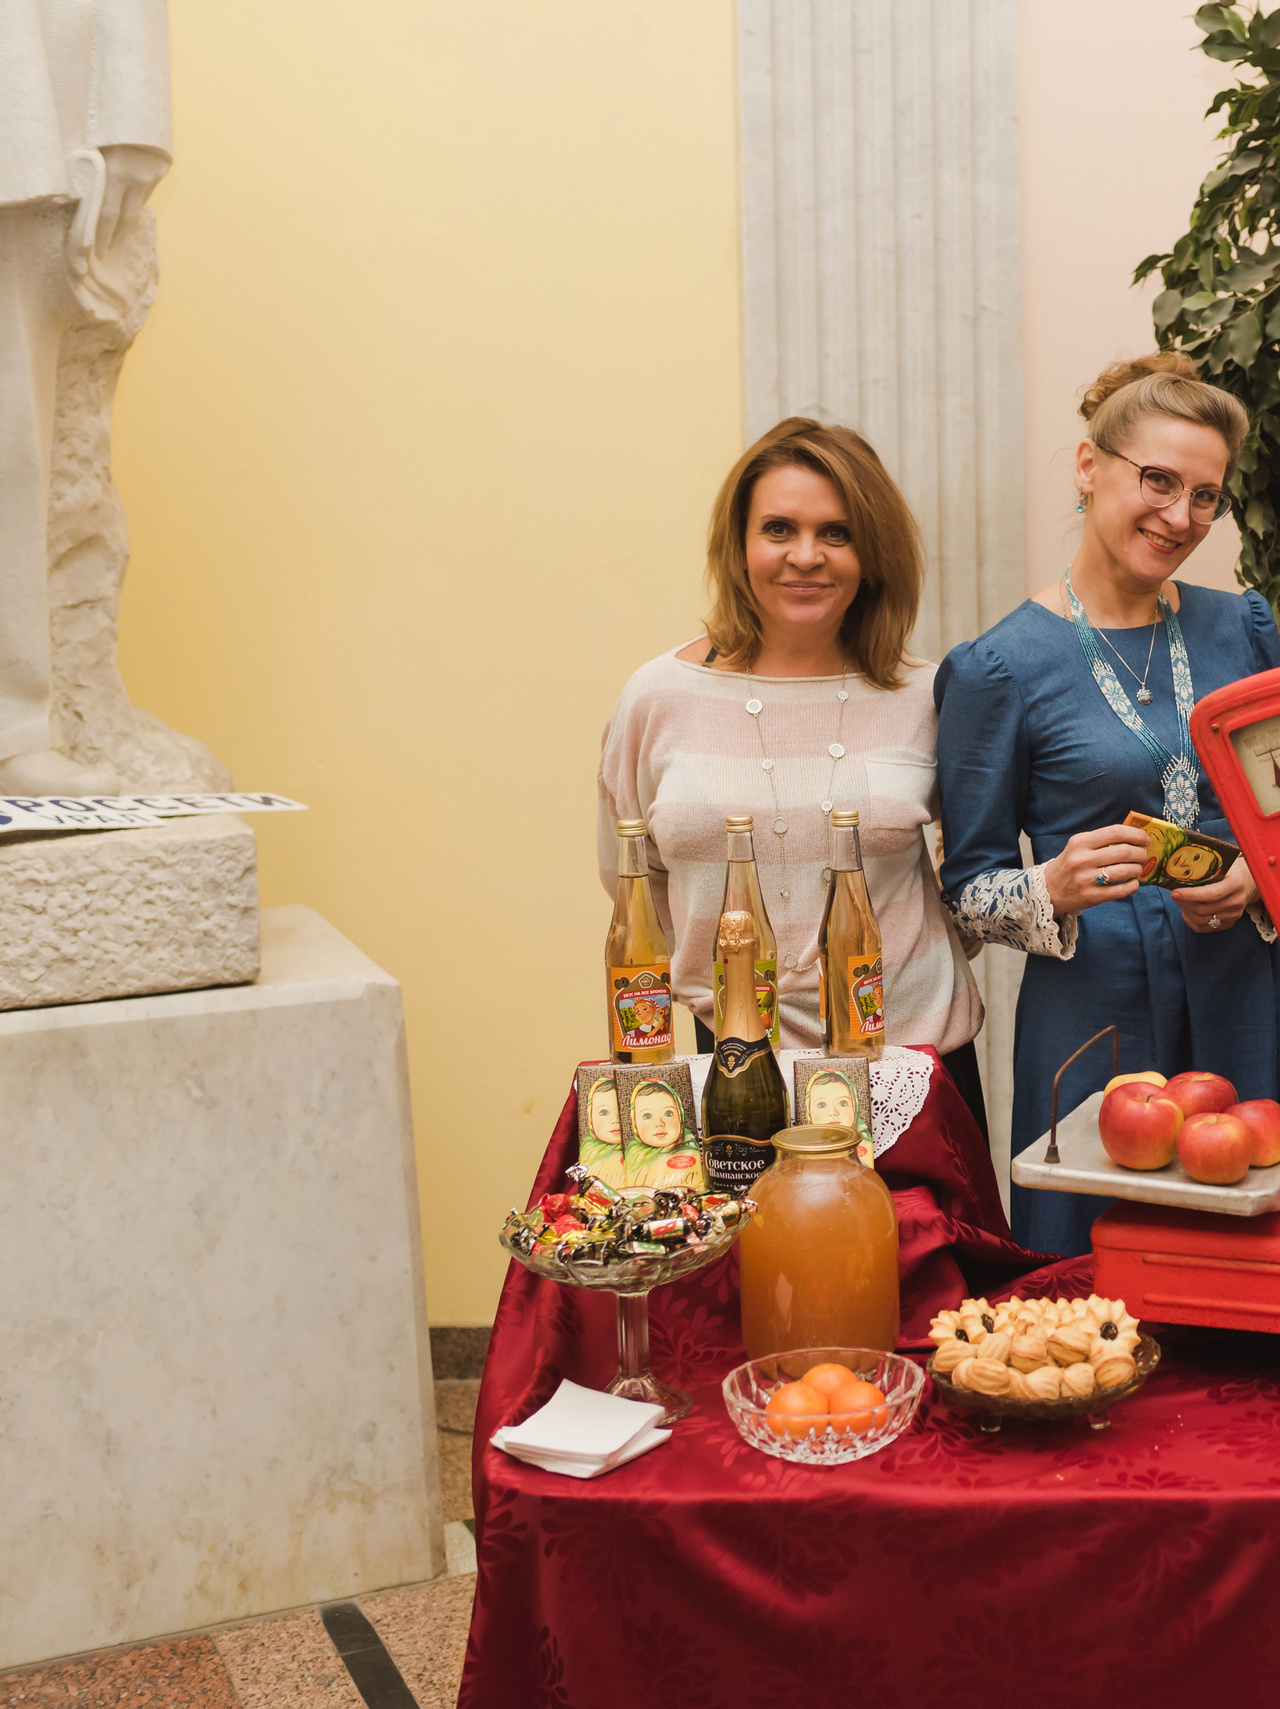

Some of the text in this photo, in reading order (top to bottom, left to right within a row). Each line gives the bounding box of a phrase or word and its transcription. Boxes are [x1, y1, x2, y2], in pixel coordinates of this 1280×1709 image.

[3, 796, 295, 813] РОССЕТИ
[38, 813, 150, 824] УРАЛ
[622, 1032, 672, 1047] Лимонад
[705, 1150, 765, 1171] Советское
